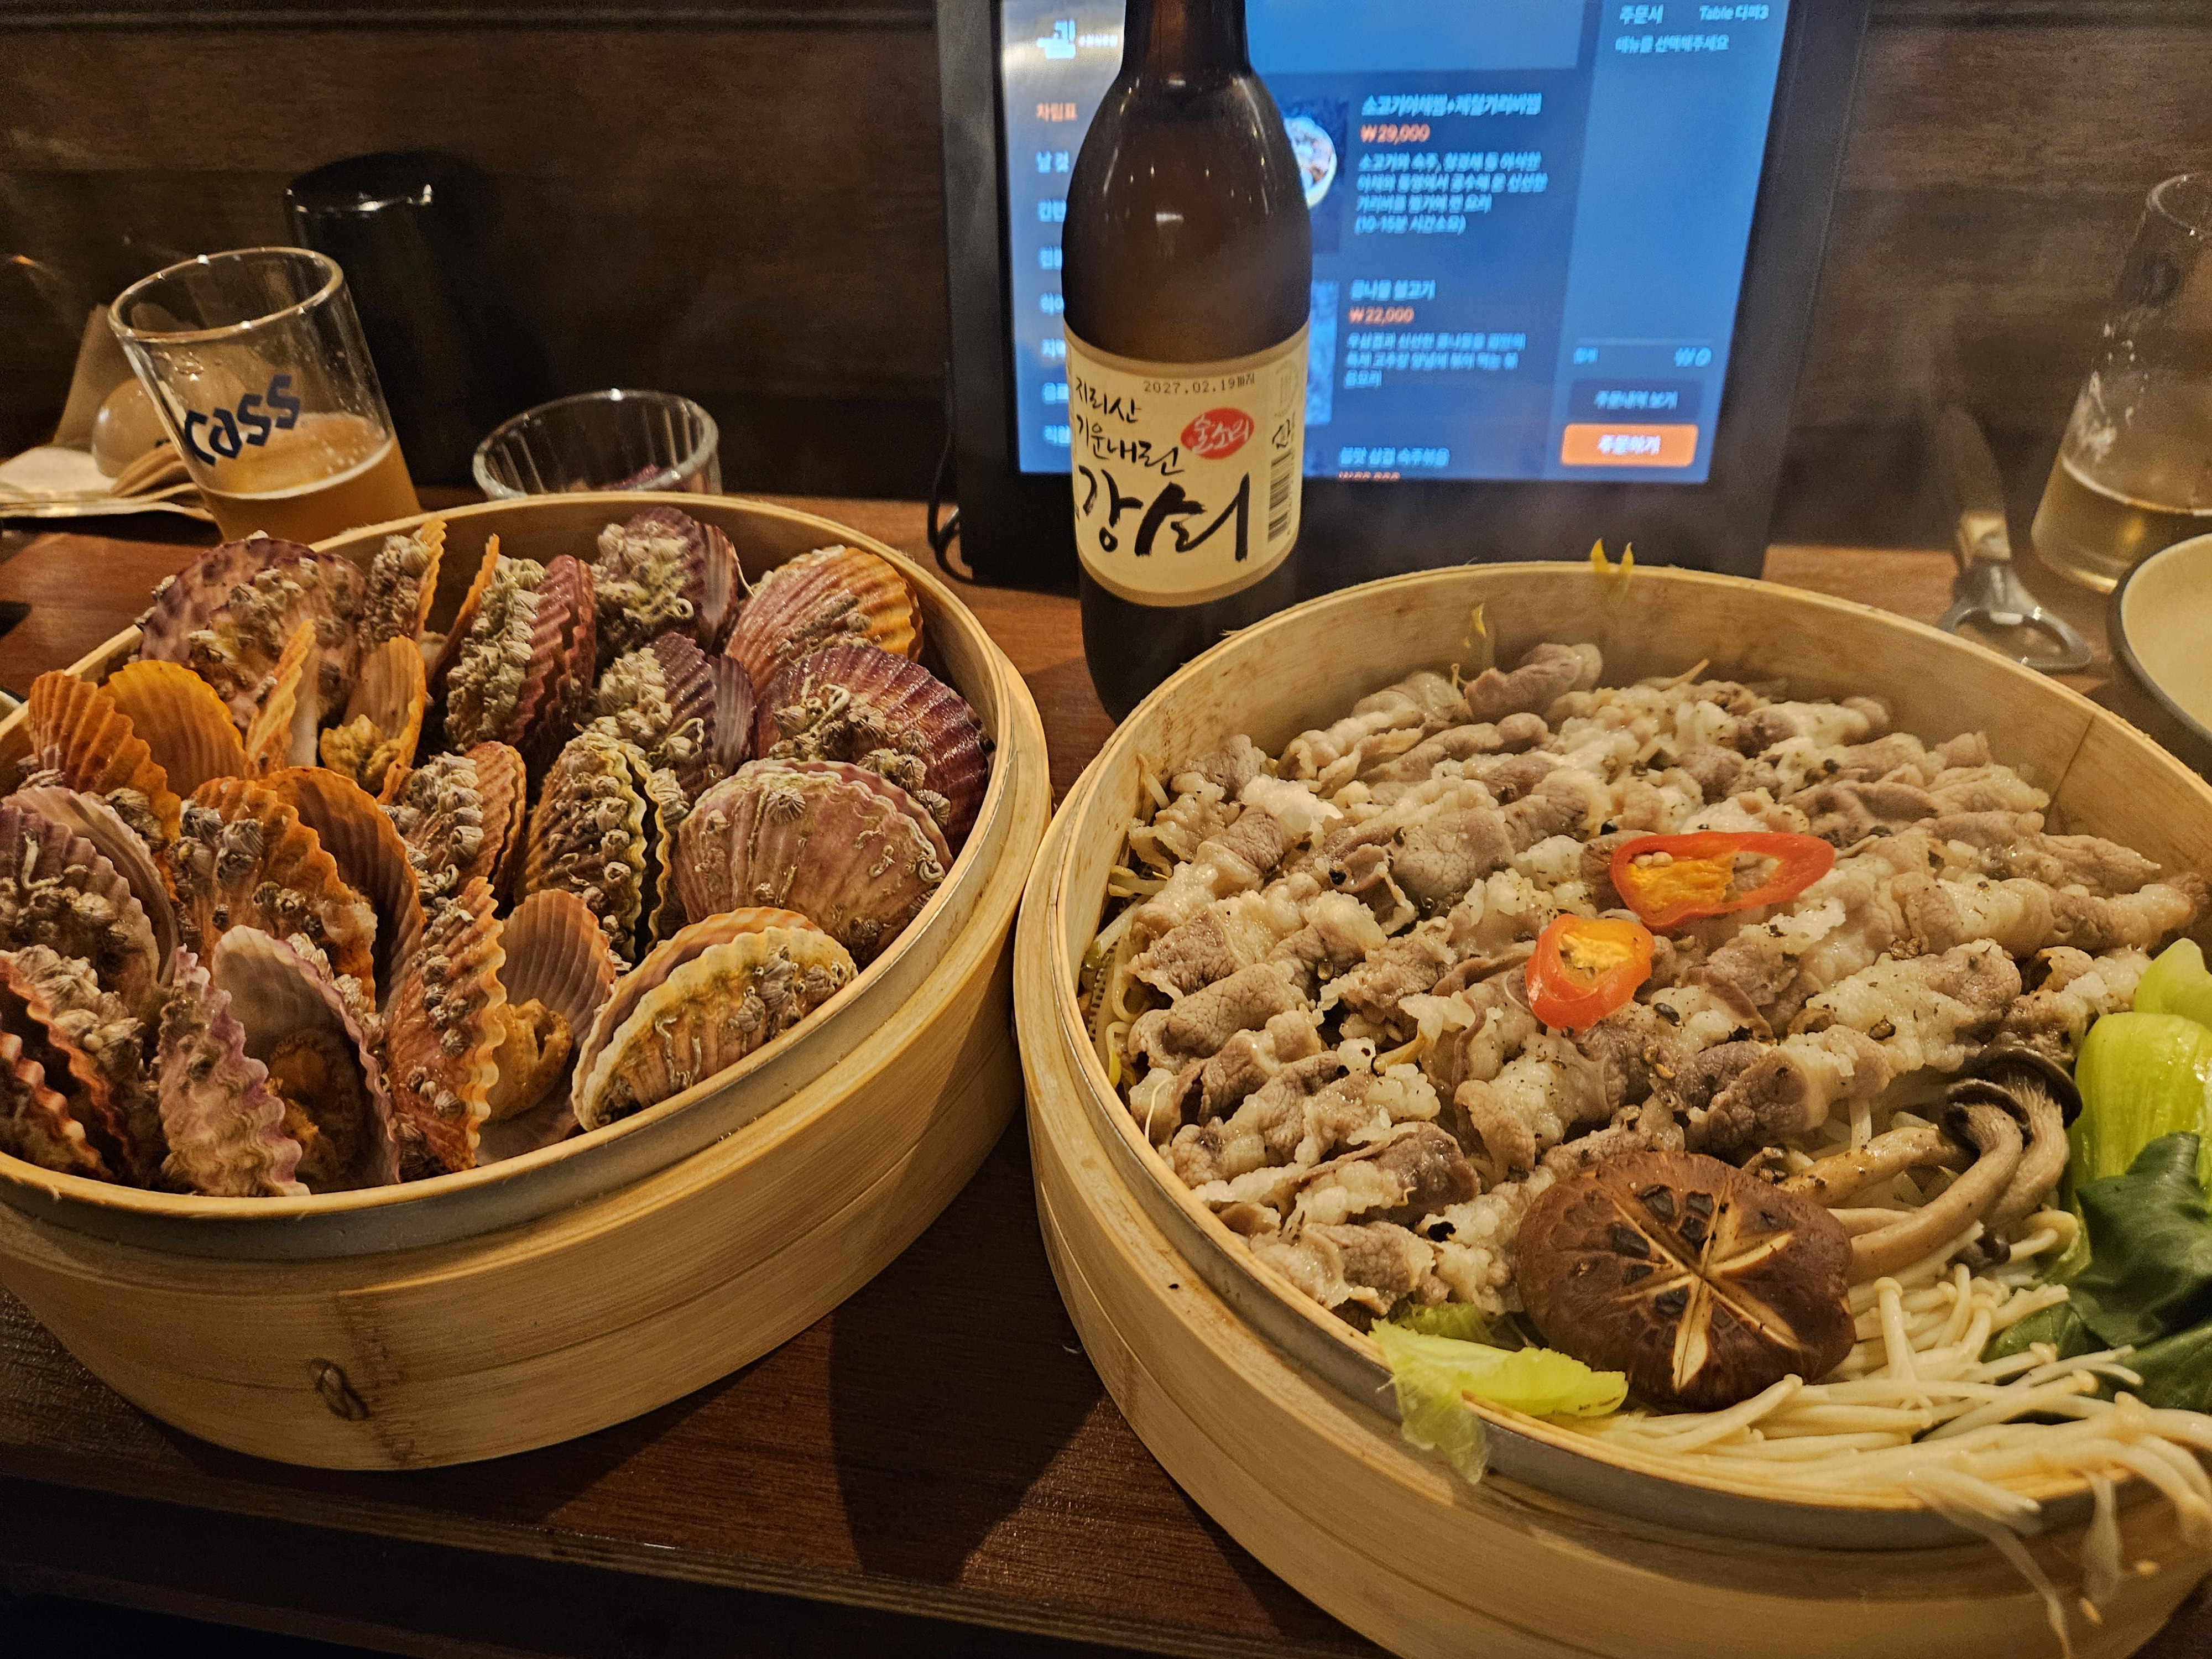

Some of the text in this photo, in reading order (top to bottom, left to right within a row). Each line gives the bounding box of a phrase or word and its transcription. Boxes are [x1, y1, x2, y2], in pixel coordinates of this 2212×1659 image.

[1699, 6, 1734, 21] Table
[1036, 103, 1077, 122] 차림표
[1076, 376, 1141, 423] 지리산
